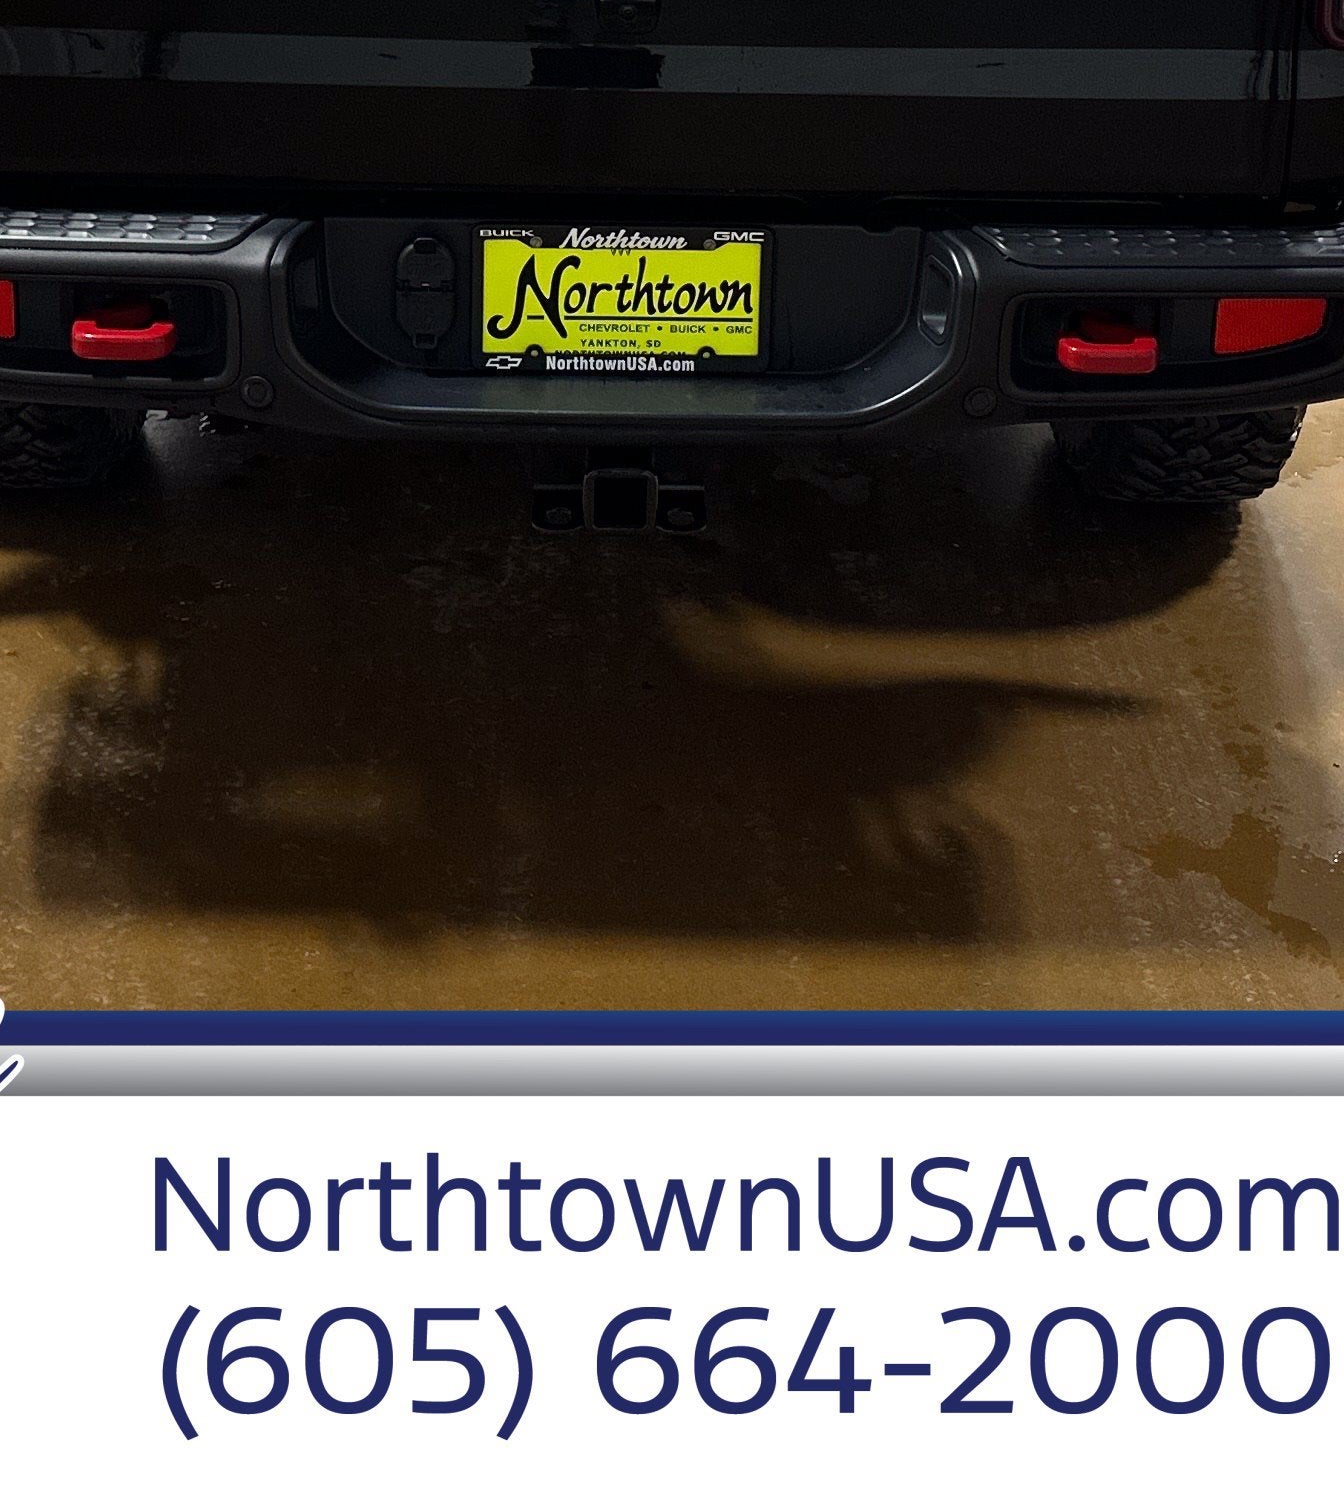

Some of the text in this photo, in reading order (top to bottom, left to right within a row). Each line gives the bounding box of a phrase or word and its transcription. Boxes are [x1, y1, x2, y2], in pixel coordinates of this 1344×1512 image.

[479, 229, 535, 238] BUICK
[558, 227, 688, 250] Northtown
[713, 231, 766, 243] GMC
[486, 254, 754, 340] Northtown
[578, 323, 753, 336] CHEVROLET BUICK GMC
[580, 339, 662, 348] YANKTON, SD
[546, 355, 695, 372] NorthtownUSA.com
